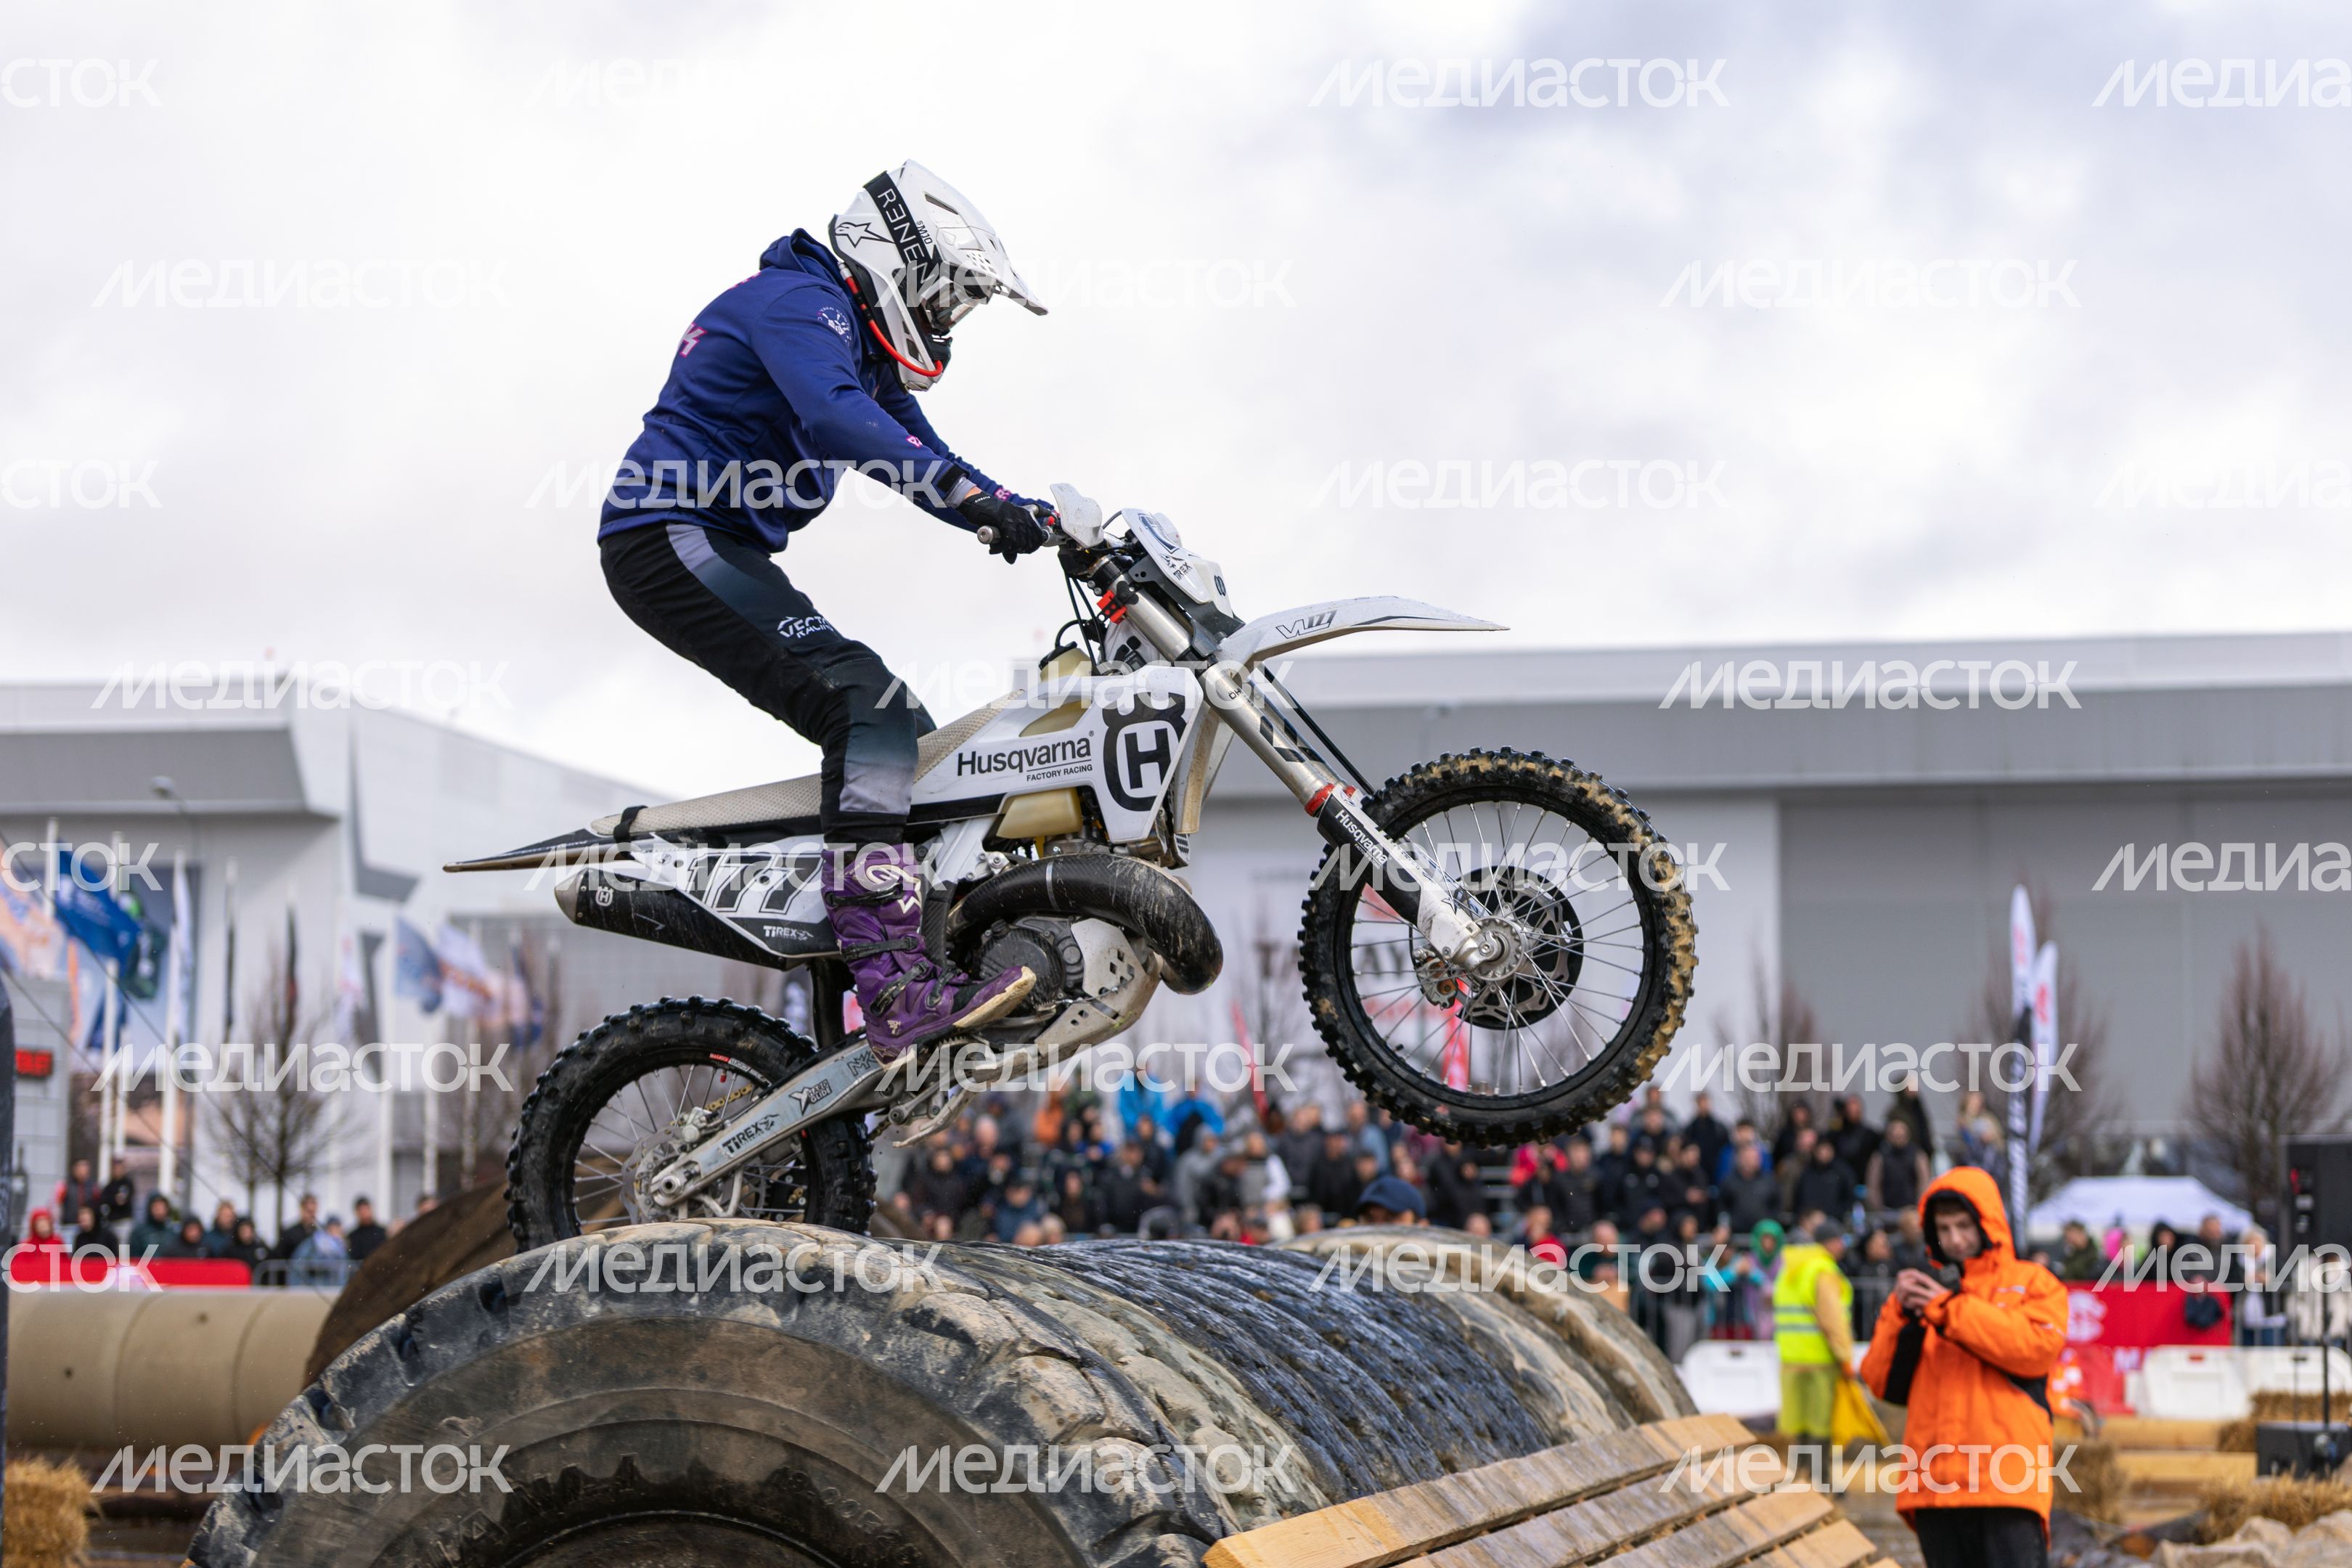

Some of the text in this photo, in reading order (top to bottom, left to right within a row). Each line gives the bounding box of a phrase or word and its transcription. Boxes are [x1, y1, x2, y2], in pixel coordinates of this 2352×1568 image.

[957, 736, 1092, 776] Husqvarna
[1026, 764, 1093, 782] FACTORY RACING
[1335, 809, 1388, 865] Husqvarna
[809, 1080, 828, 1097] HARD
